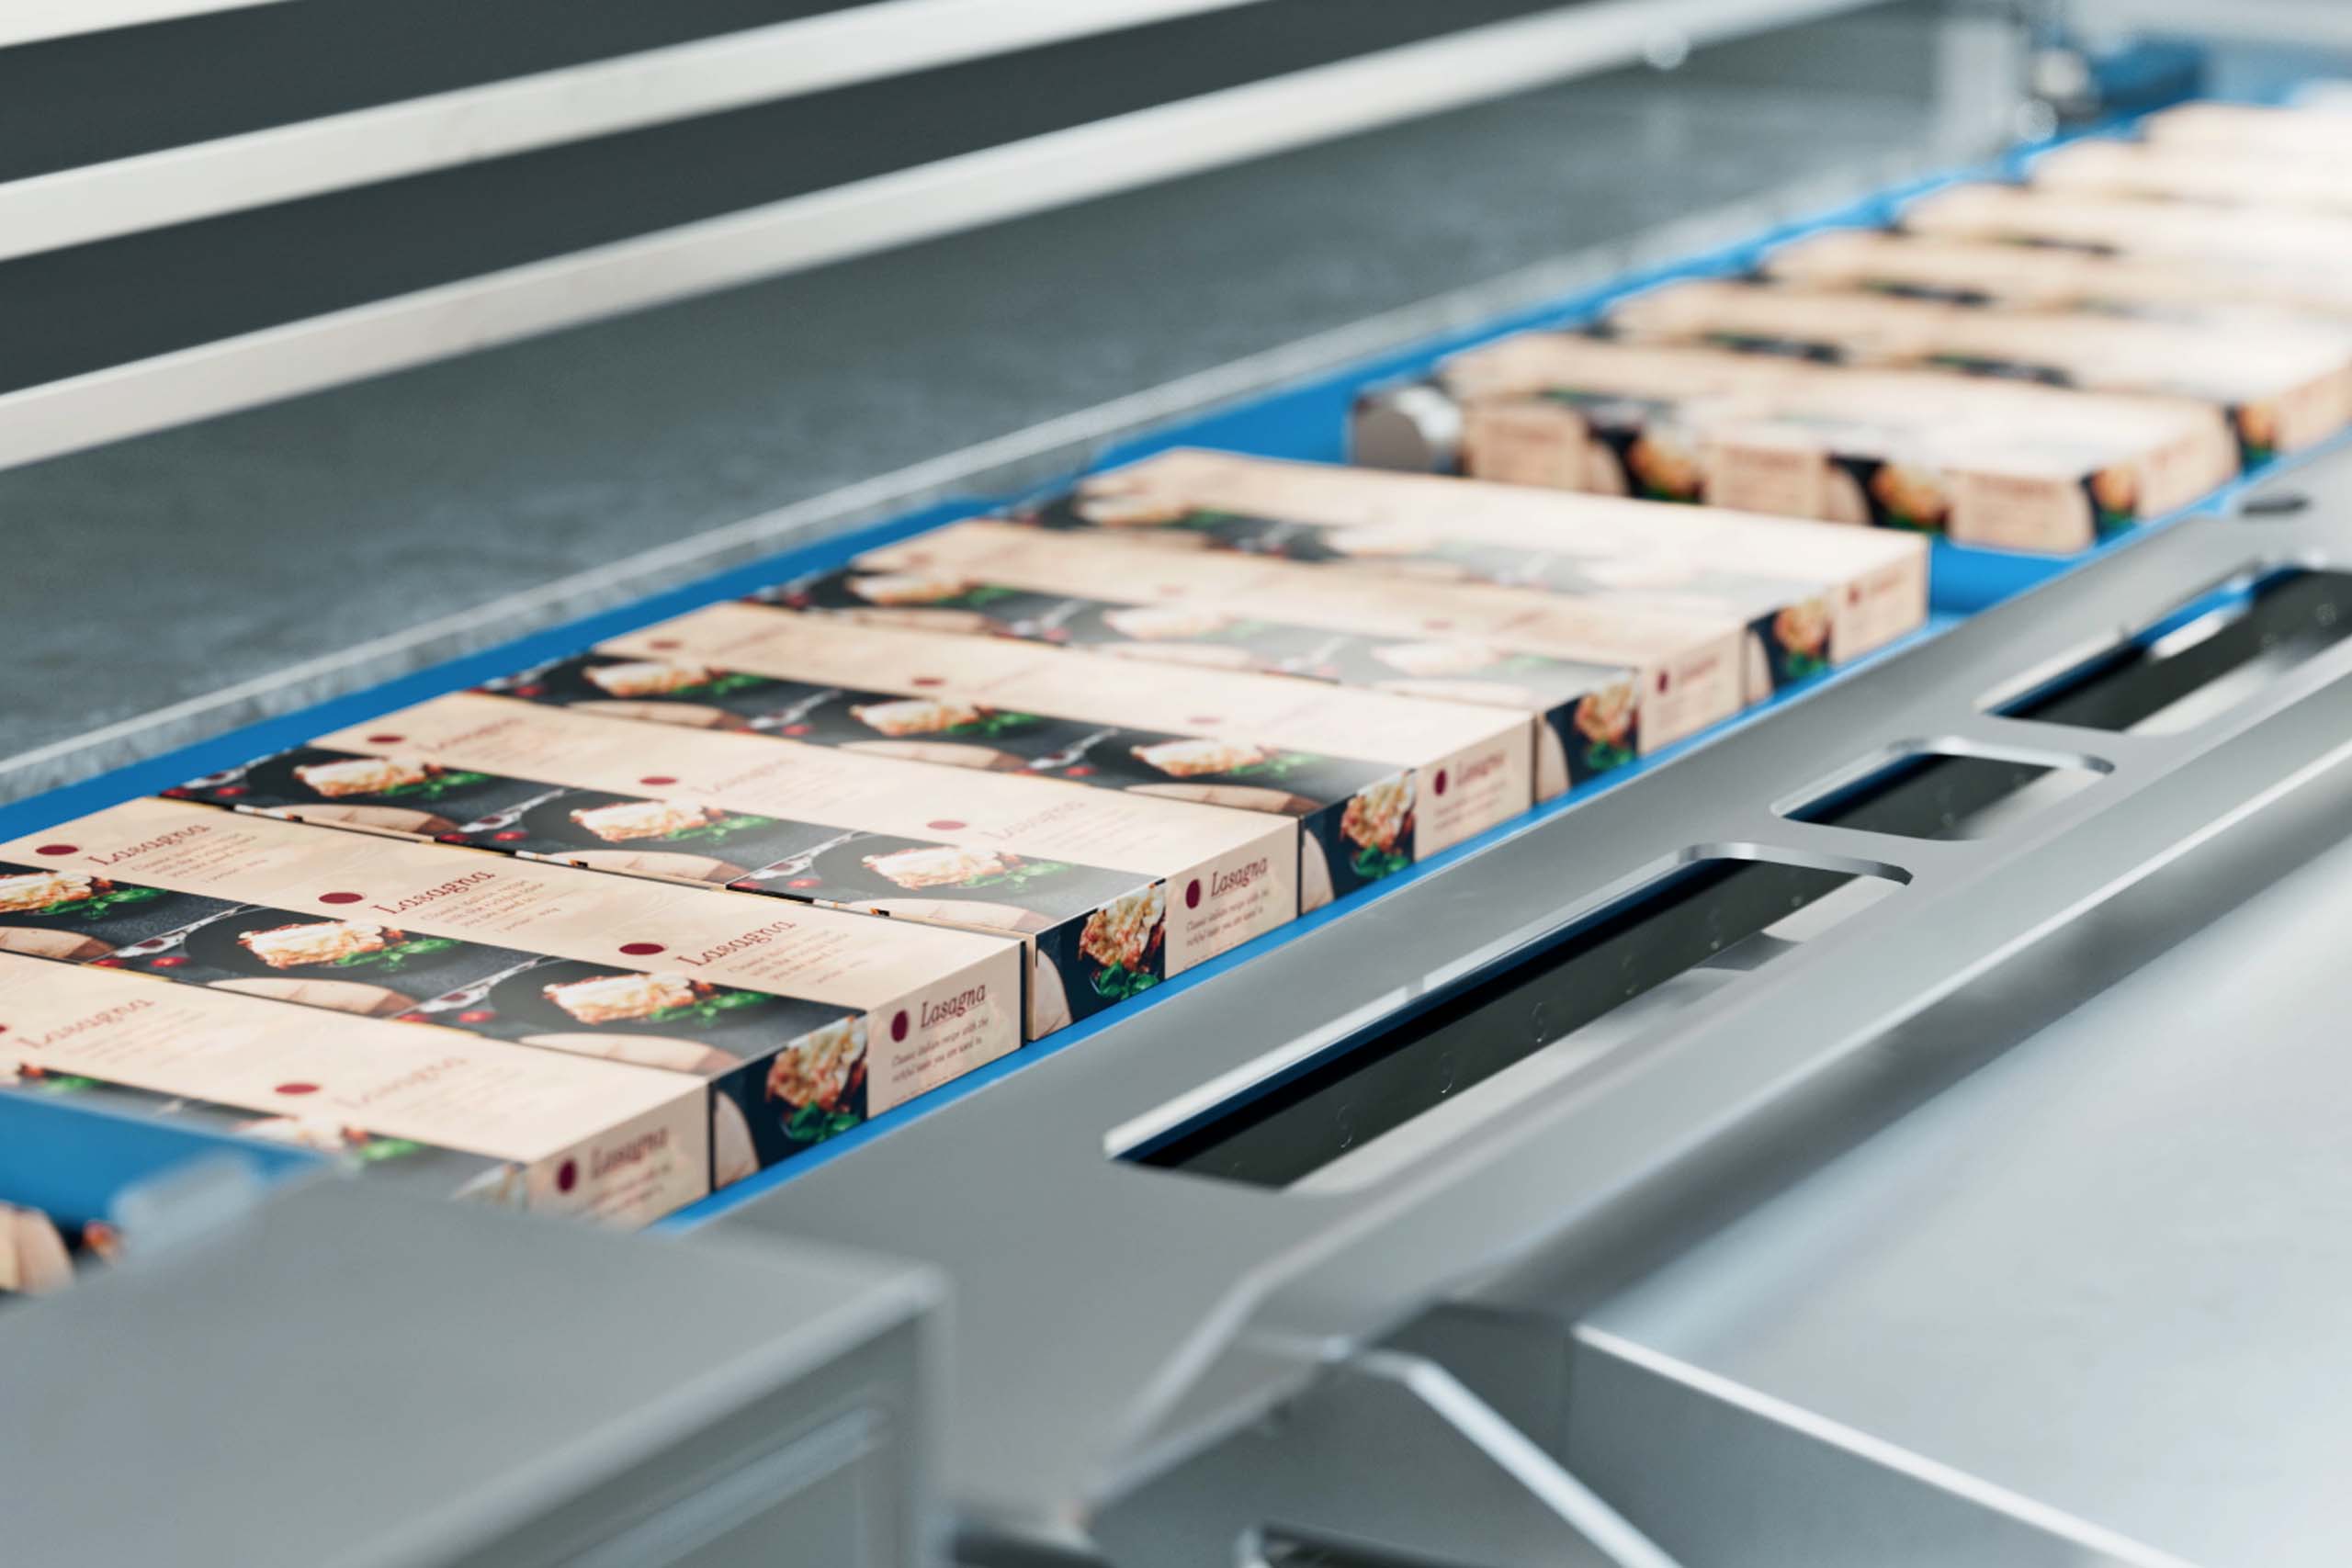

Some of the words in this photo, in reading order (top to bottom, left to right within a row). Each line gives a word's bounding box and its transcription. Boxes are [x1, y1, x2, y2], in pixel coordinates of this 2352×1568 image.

[85, 825, 211, 865] Lasagna
[371, 872, 495, 915] Lasagna
[1211, 857, 1268, 897] Lasagna
[673, 920, 797, 966] Lasagna
[921, 985, 986, 1028] Lasagna
[590, 1127, 669, 1179] Lasagna
